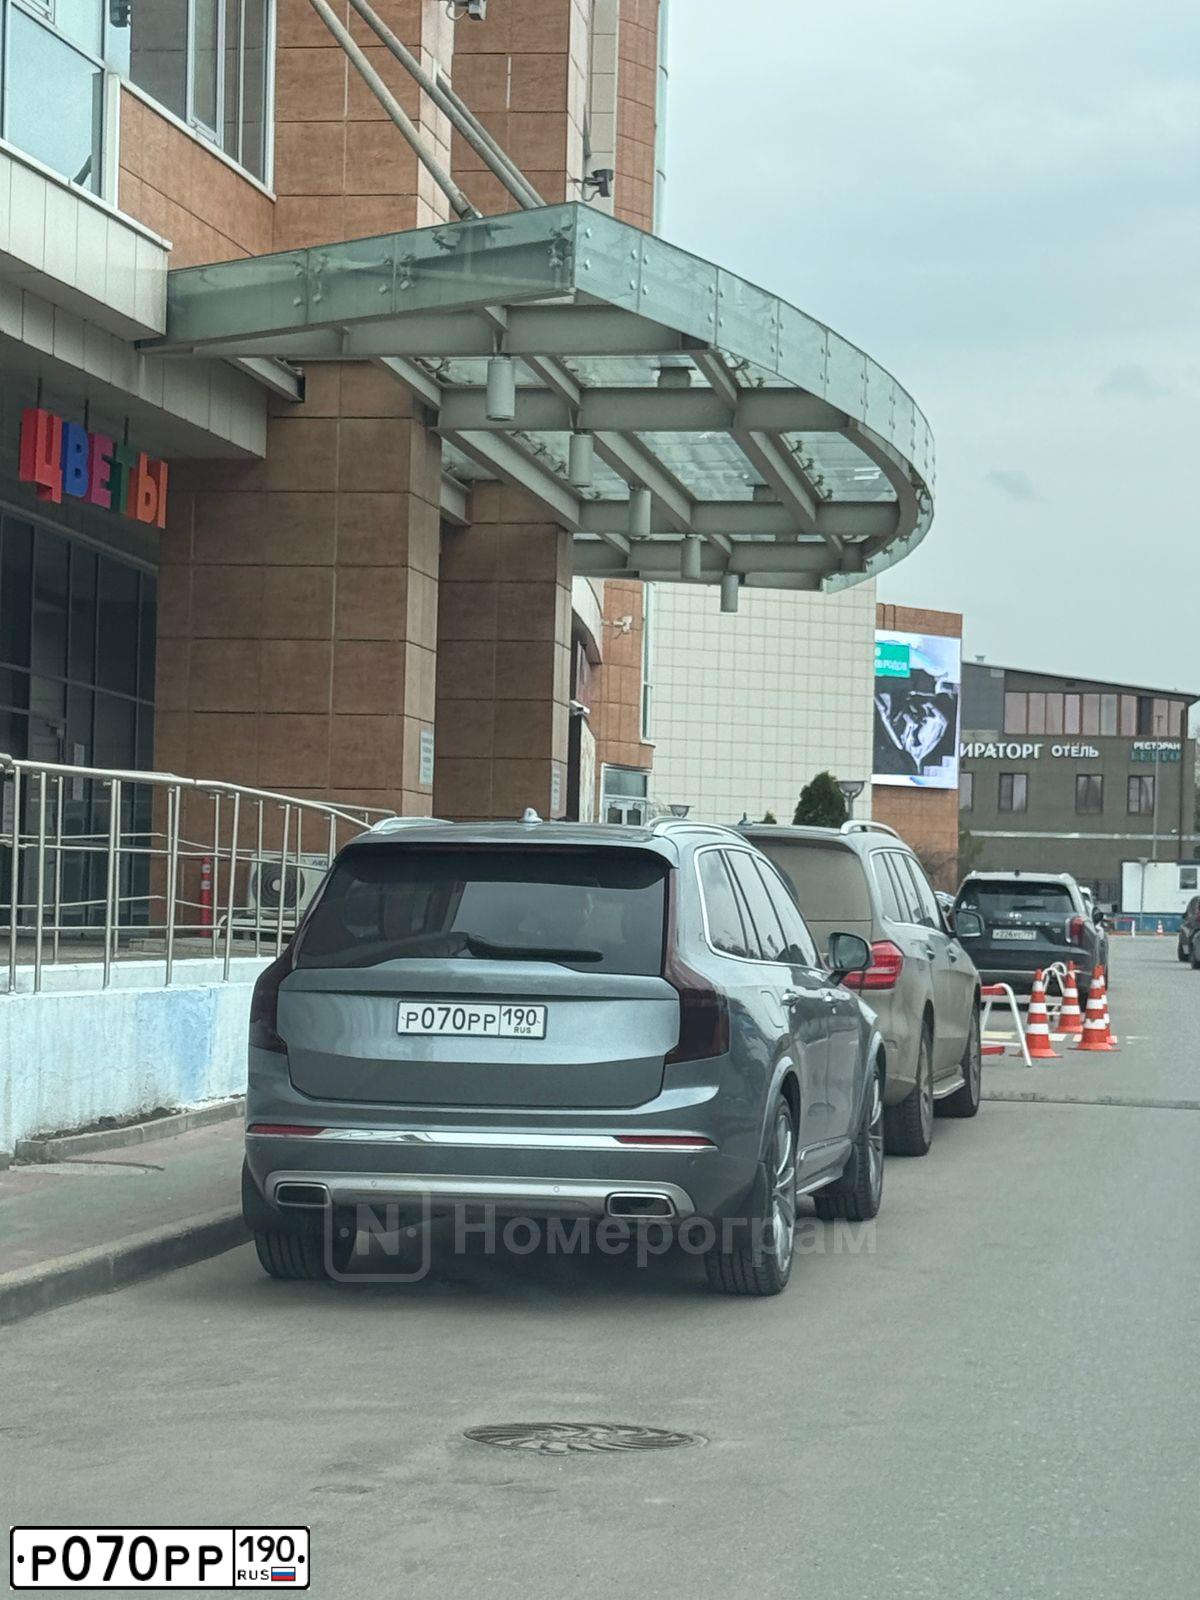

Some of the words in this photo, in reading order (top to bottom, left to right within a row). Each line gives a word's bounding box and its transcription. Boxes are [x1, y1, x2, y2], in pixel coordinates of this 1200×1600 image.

[19, 408, 168, 529] ЦВЕТЫ
[1051, 744, 1099, 758] ОТЕЛЬ
[1133, 741, 1181, 750] РЕСТОРАН
[502, 1008, 537, 1026] 190
[513, 1026, 532, 1034] RUS
